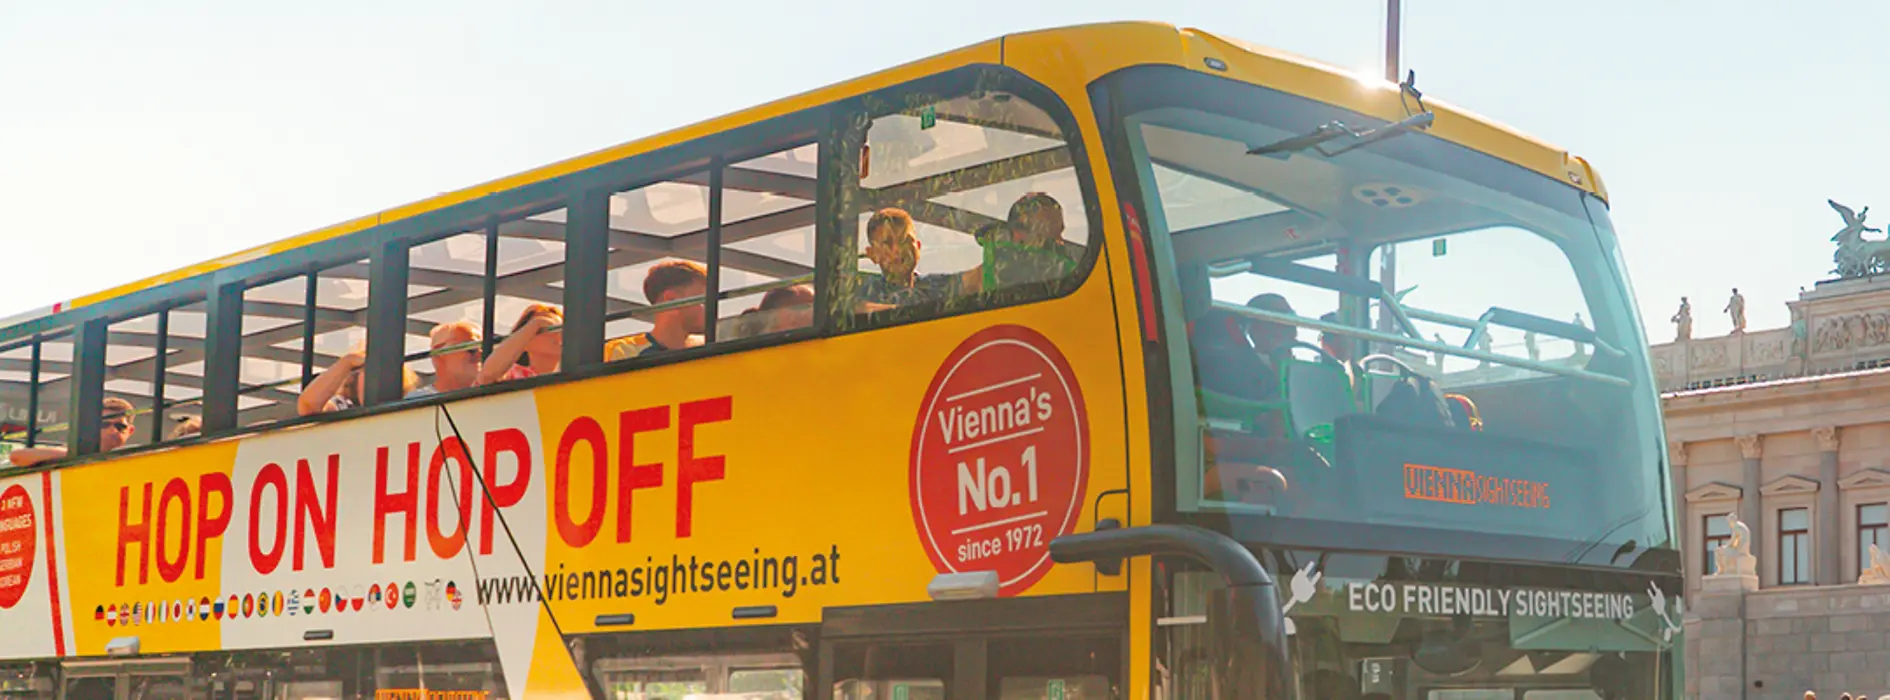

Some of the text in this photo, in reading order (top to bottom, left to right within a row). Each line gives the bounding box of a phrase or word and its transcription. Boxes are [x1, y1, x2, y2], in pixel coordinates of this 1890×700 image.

[938, 386, 1054, 445] Vienna's
[115, 395, 733, 587] HOP ON HOP OFF
[957, 445, 1039, 516] No.1
[957, 523, 1043, 563] since 1972
[476, 544, 841, 606] www.viennasightseeing.at
[1349, 583, 1634, 619] ECO FRIENDLY SIGHTSEEING
